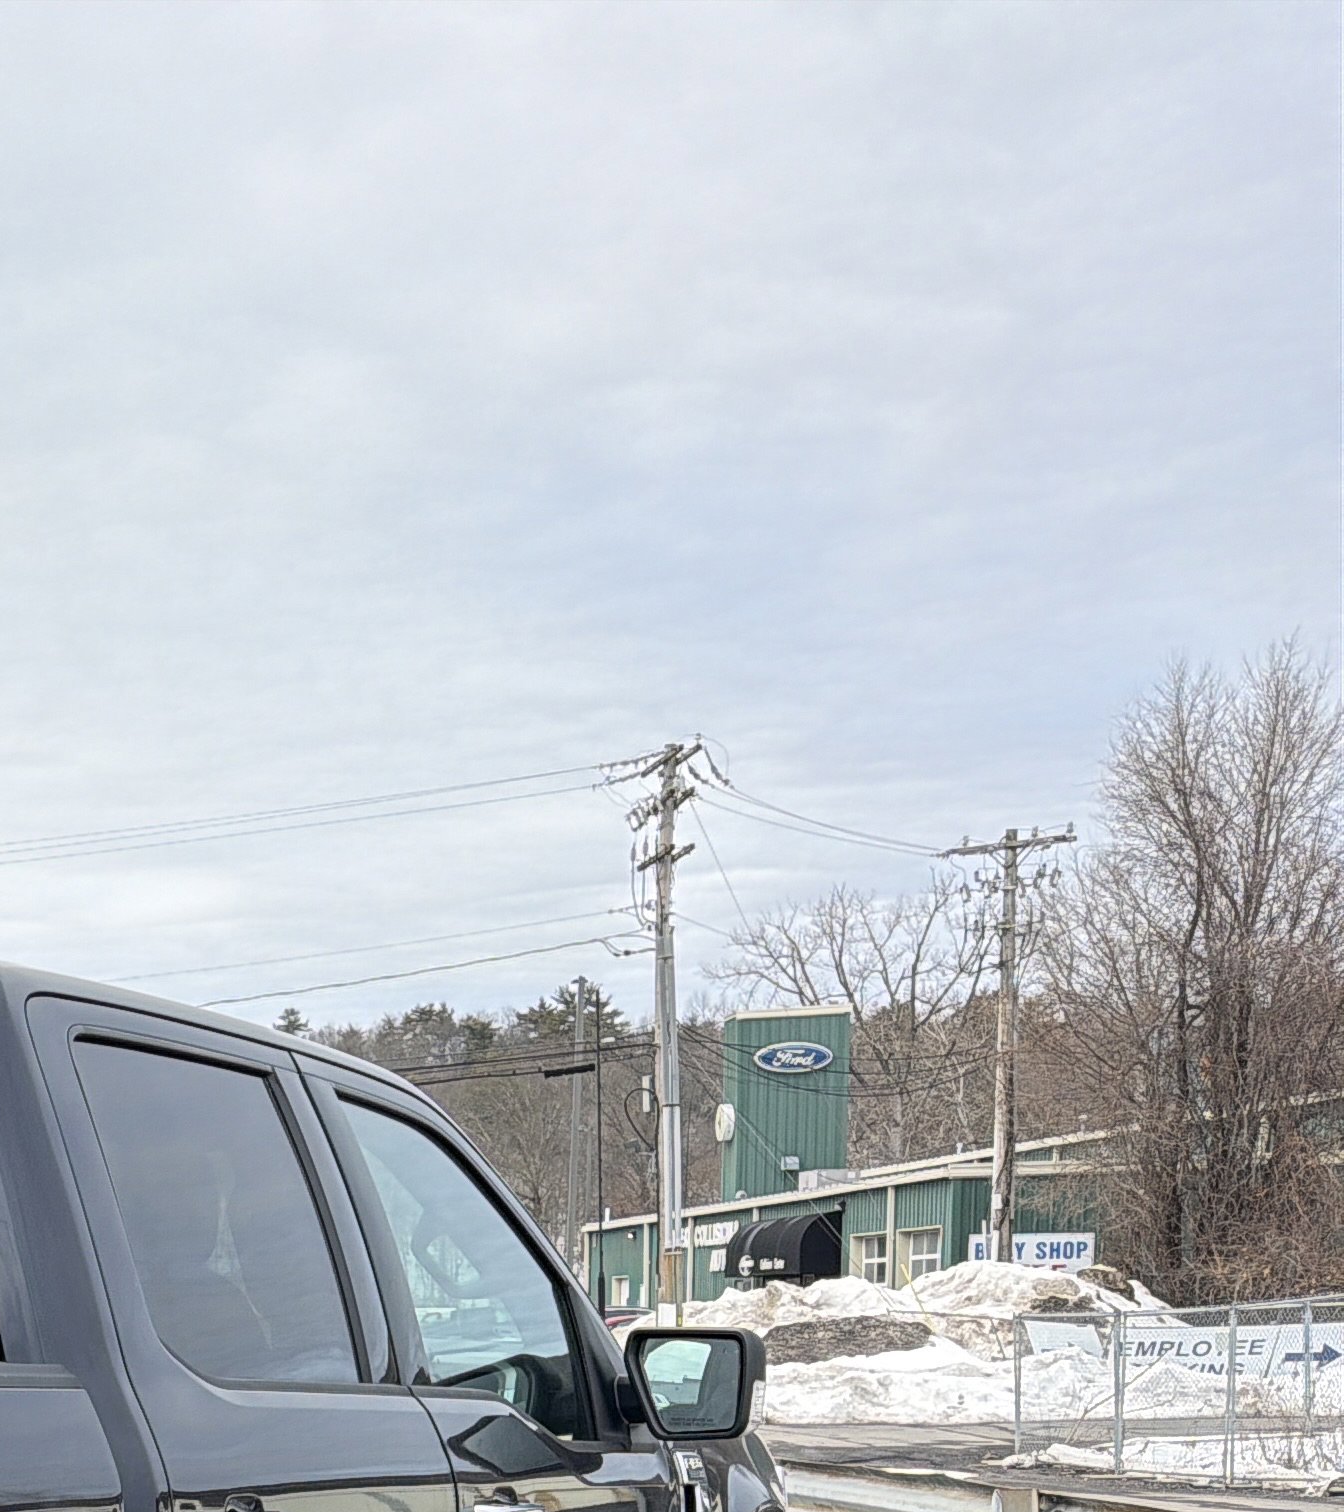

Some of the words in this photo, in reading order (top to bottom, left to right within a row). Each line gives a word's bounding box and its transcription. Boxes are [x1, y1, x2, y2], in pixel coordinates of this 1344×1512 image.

[772, 1049, 817, 1067] Ford
[974, 1241, 1026, 1260] BY
[1034, 1241, 1088, 1260] SHOP
